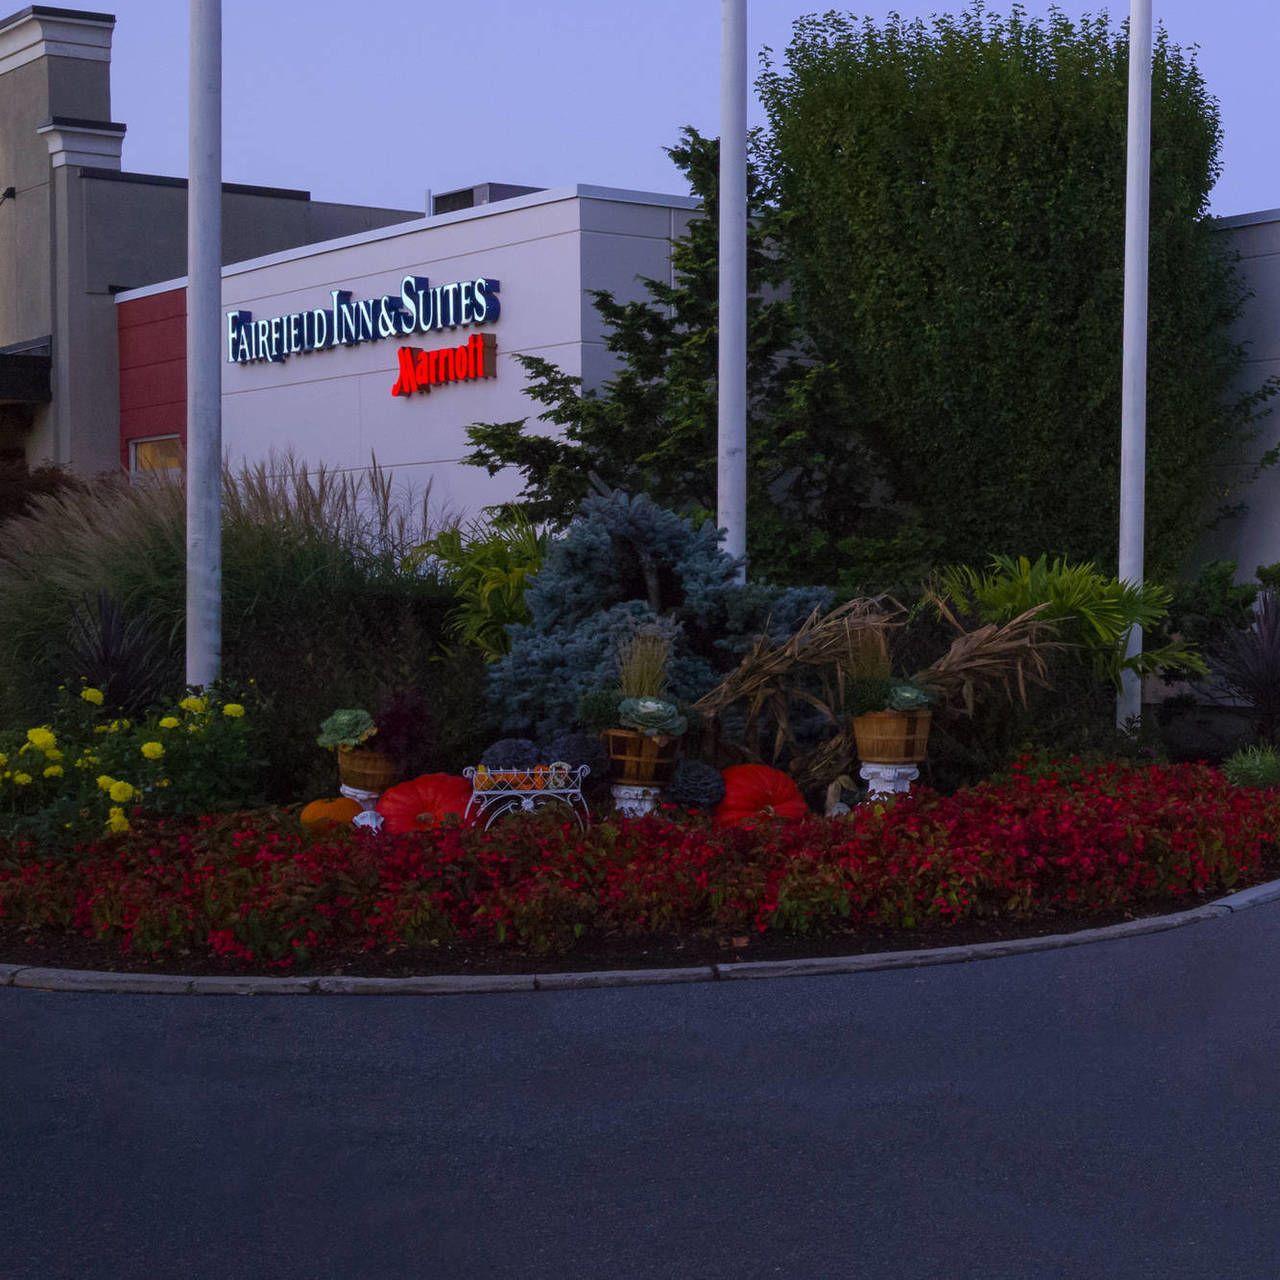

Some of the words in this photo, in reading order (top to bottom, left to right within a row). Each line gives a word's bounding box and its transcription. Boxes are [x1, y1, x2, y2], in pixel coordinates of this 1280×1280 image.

[226, 308, 328, 362] FAIRFIELD
[330, 291, 374, 345] INN
[378, 295, 398, 337] &
[401, 275, 487, 334] SUITES
[391, 333, 485, 397] Marriott
